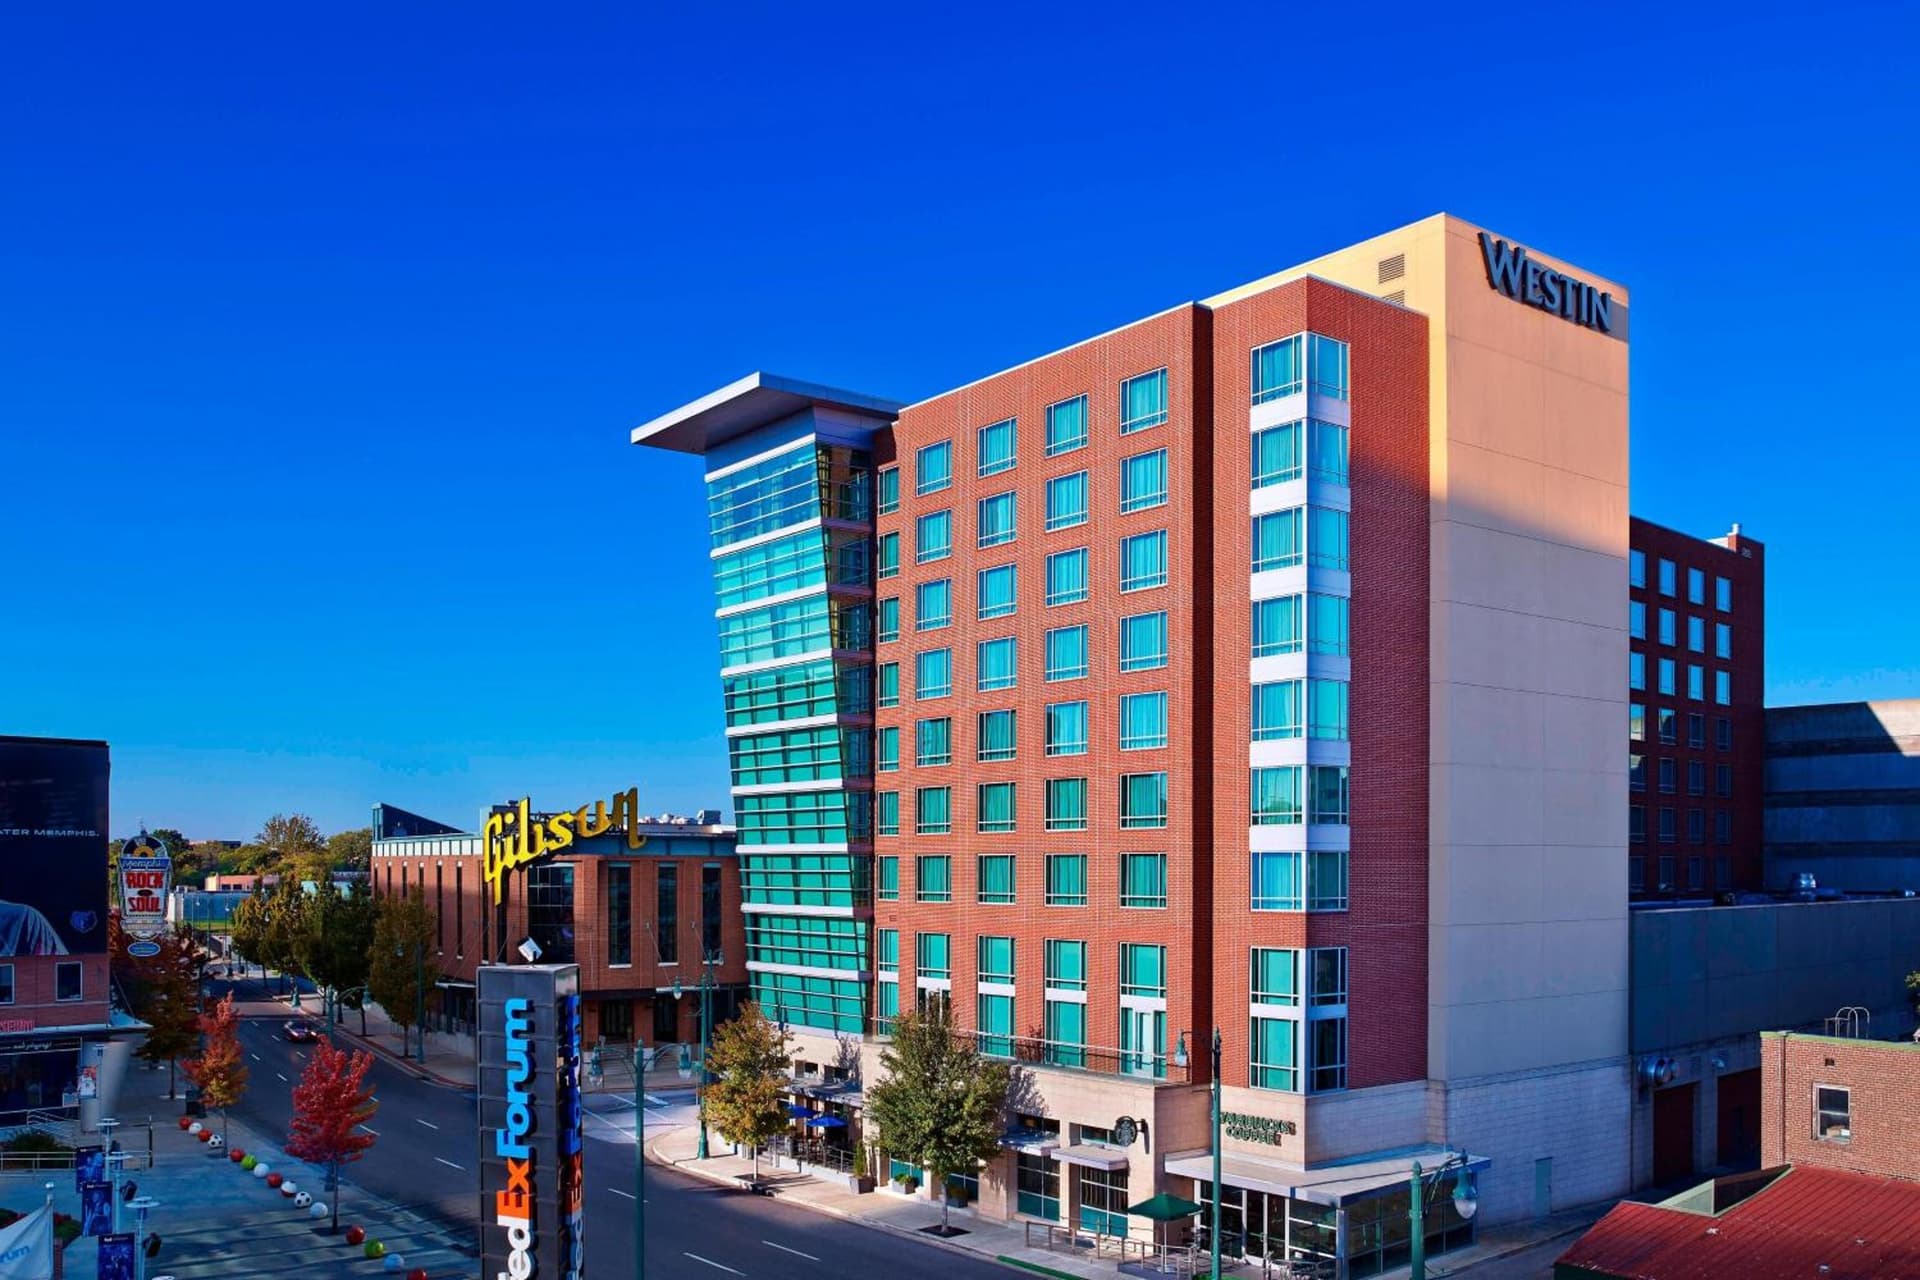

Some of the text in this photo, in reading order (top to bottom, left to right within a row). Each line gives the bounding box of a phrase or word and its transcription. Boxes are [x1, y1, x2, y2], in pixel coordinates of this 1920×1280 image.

[1477, 231, 1612, 333] WESTIN
[483, 785, 647, 907] Gibson
[126, 872, 164, 888] ROCK
[128, 896, 161, 912] SOUL
